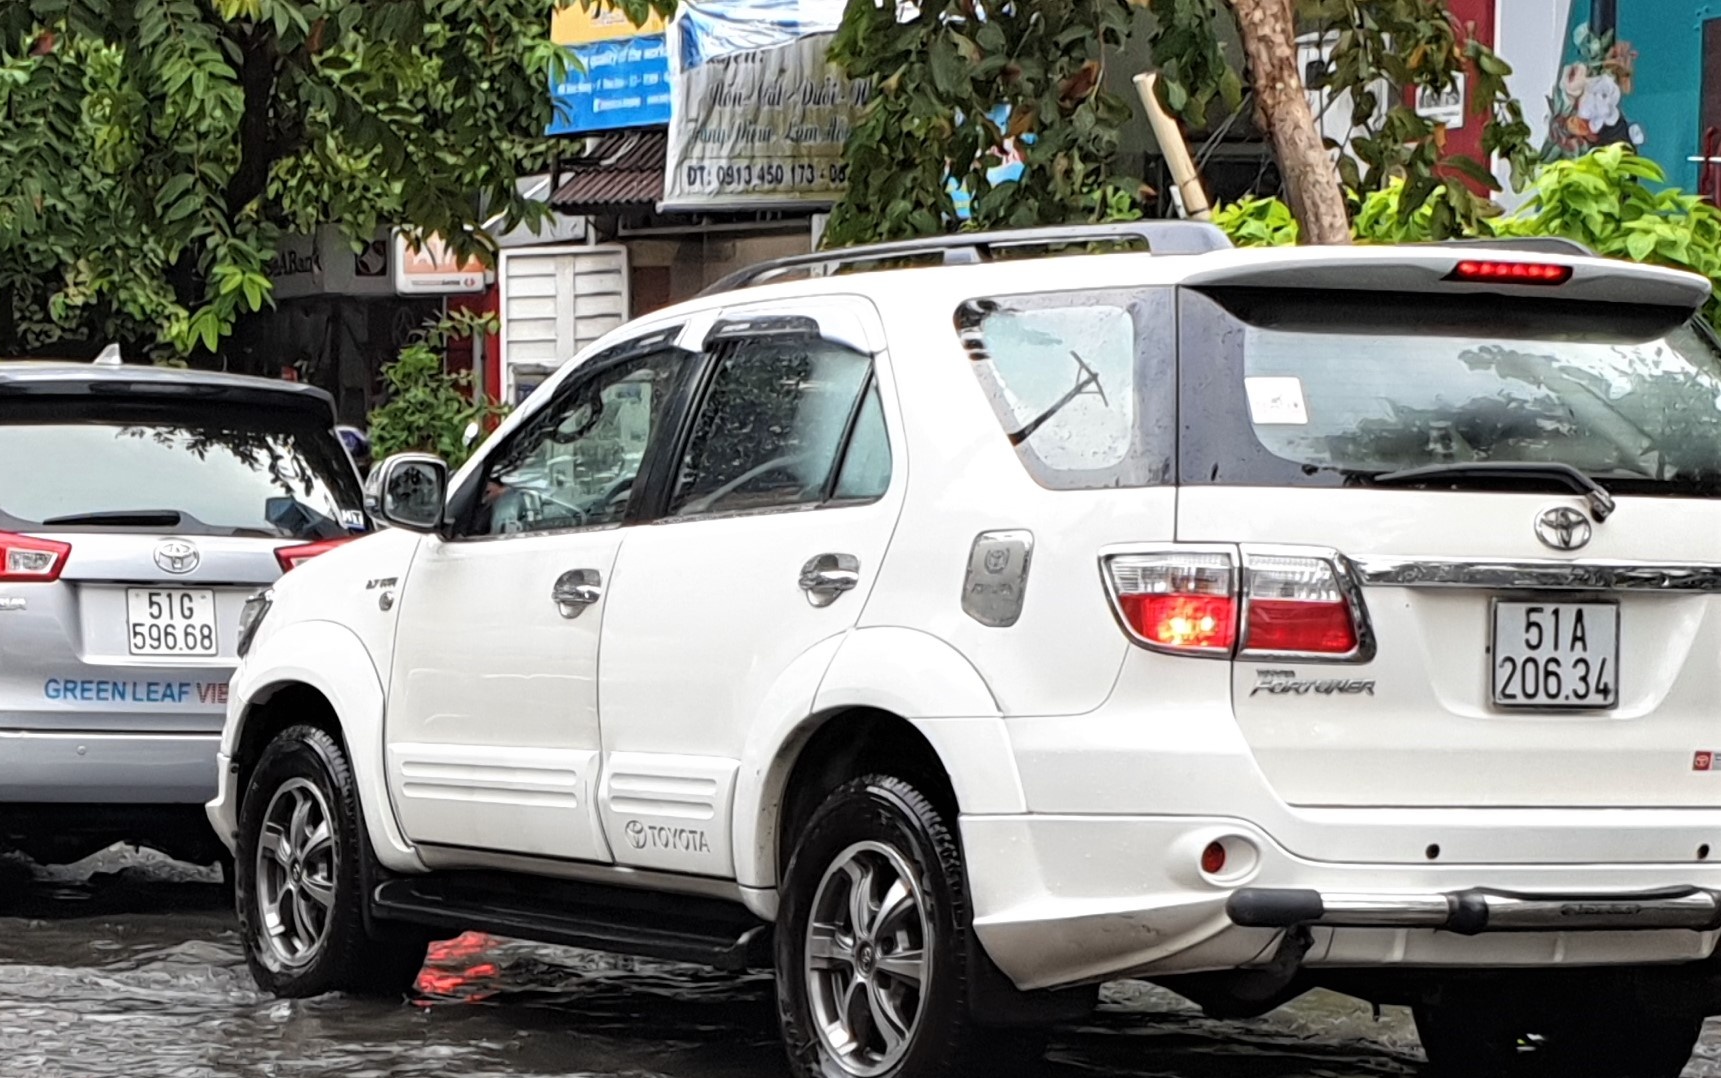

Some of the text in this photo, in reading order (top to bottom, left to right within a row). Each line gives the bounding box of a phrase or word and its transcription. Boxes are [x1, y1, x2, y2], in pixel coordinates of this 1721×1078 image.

[716, 164, 753, 186] 0913
[757, 164, 784, 185] 450
[791, 163, 815, 185] 173
[147, 592, 194, 621] 51G
[131, 622, 213, 652] 596.68
[1524, 606, 1588, 652] 51A
[44, 678, 127, 702] GREEN
[132, 682, 191, 703] LEAF
[1498, 655, 1612, 701] 206.34
[647, 825, 711, 853] TOYOTA
